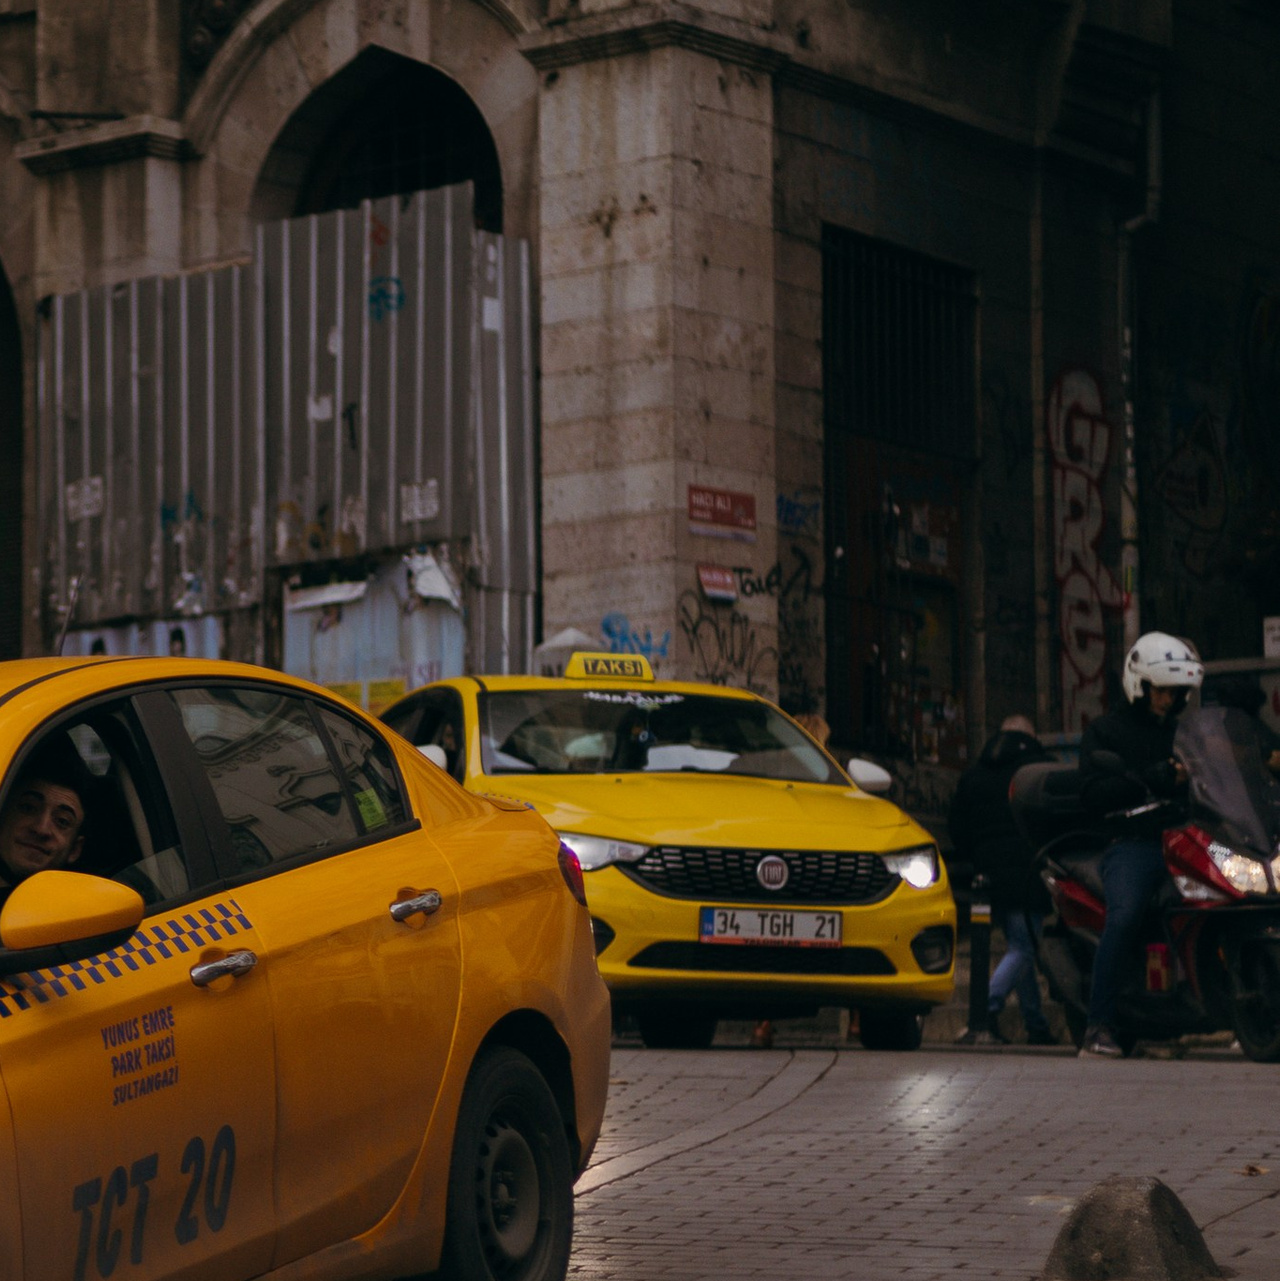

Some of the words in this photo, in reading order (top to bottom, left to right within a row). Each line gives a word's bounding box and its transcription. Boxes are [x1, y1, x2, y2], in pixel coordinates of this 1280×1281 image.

[717, 912, 740, 935] 34
[758, 913, 794, 936] TGH
[815, 916, 835, 938] 21
[100, 1017, 140, 1050] YUNUS
[141, 1005, 175, 1035] EMRE
[111, 1047, 142, 1078] PARK
[174, 1124, 236, 1245] 20
